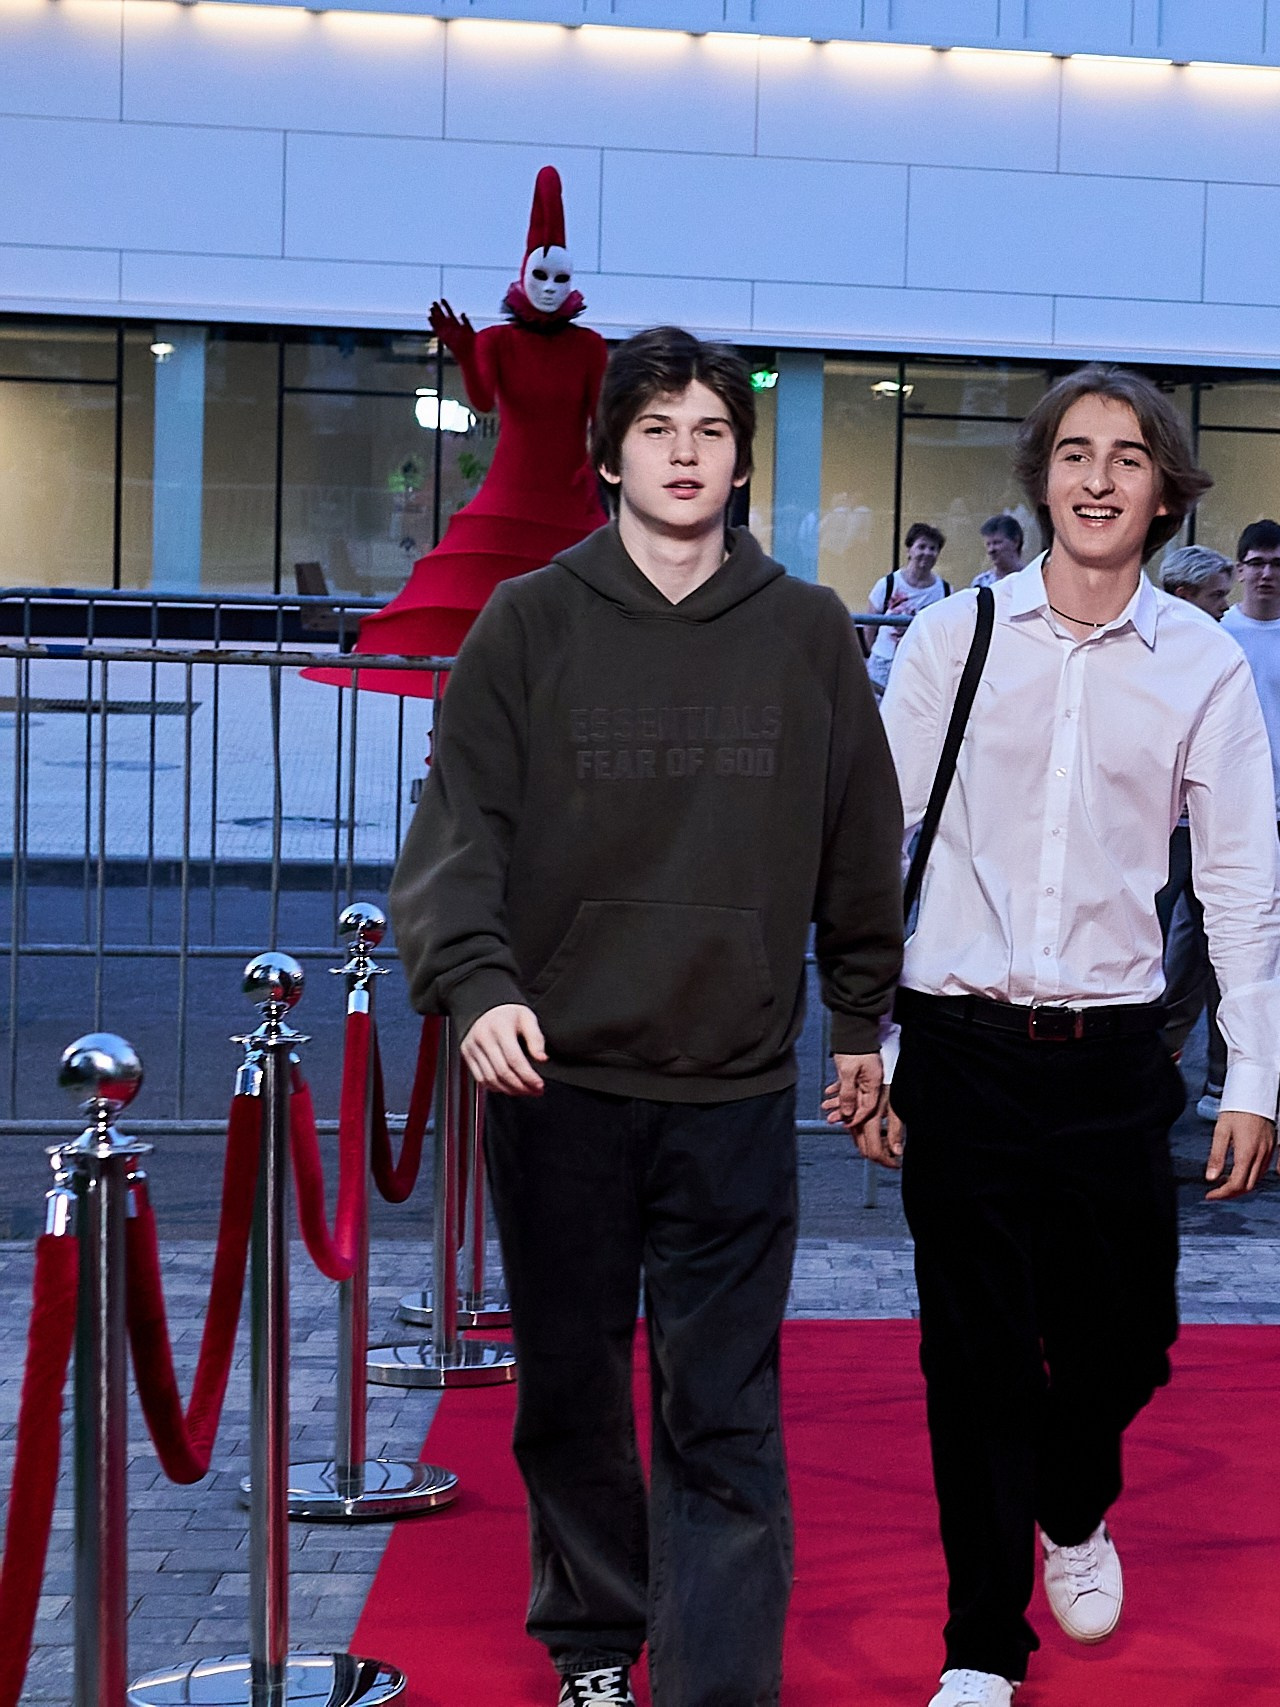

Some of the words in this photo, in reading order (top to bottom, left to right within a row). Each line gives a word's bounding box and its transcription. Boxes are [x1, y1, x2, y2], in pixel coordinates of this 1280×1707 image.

[569, 705, 783, 742] ESSENTIALS
[576, 749, 657, 779] FEAR
[666, 747, 704, 777] OF
[715, 746, 775, 777] GOD
